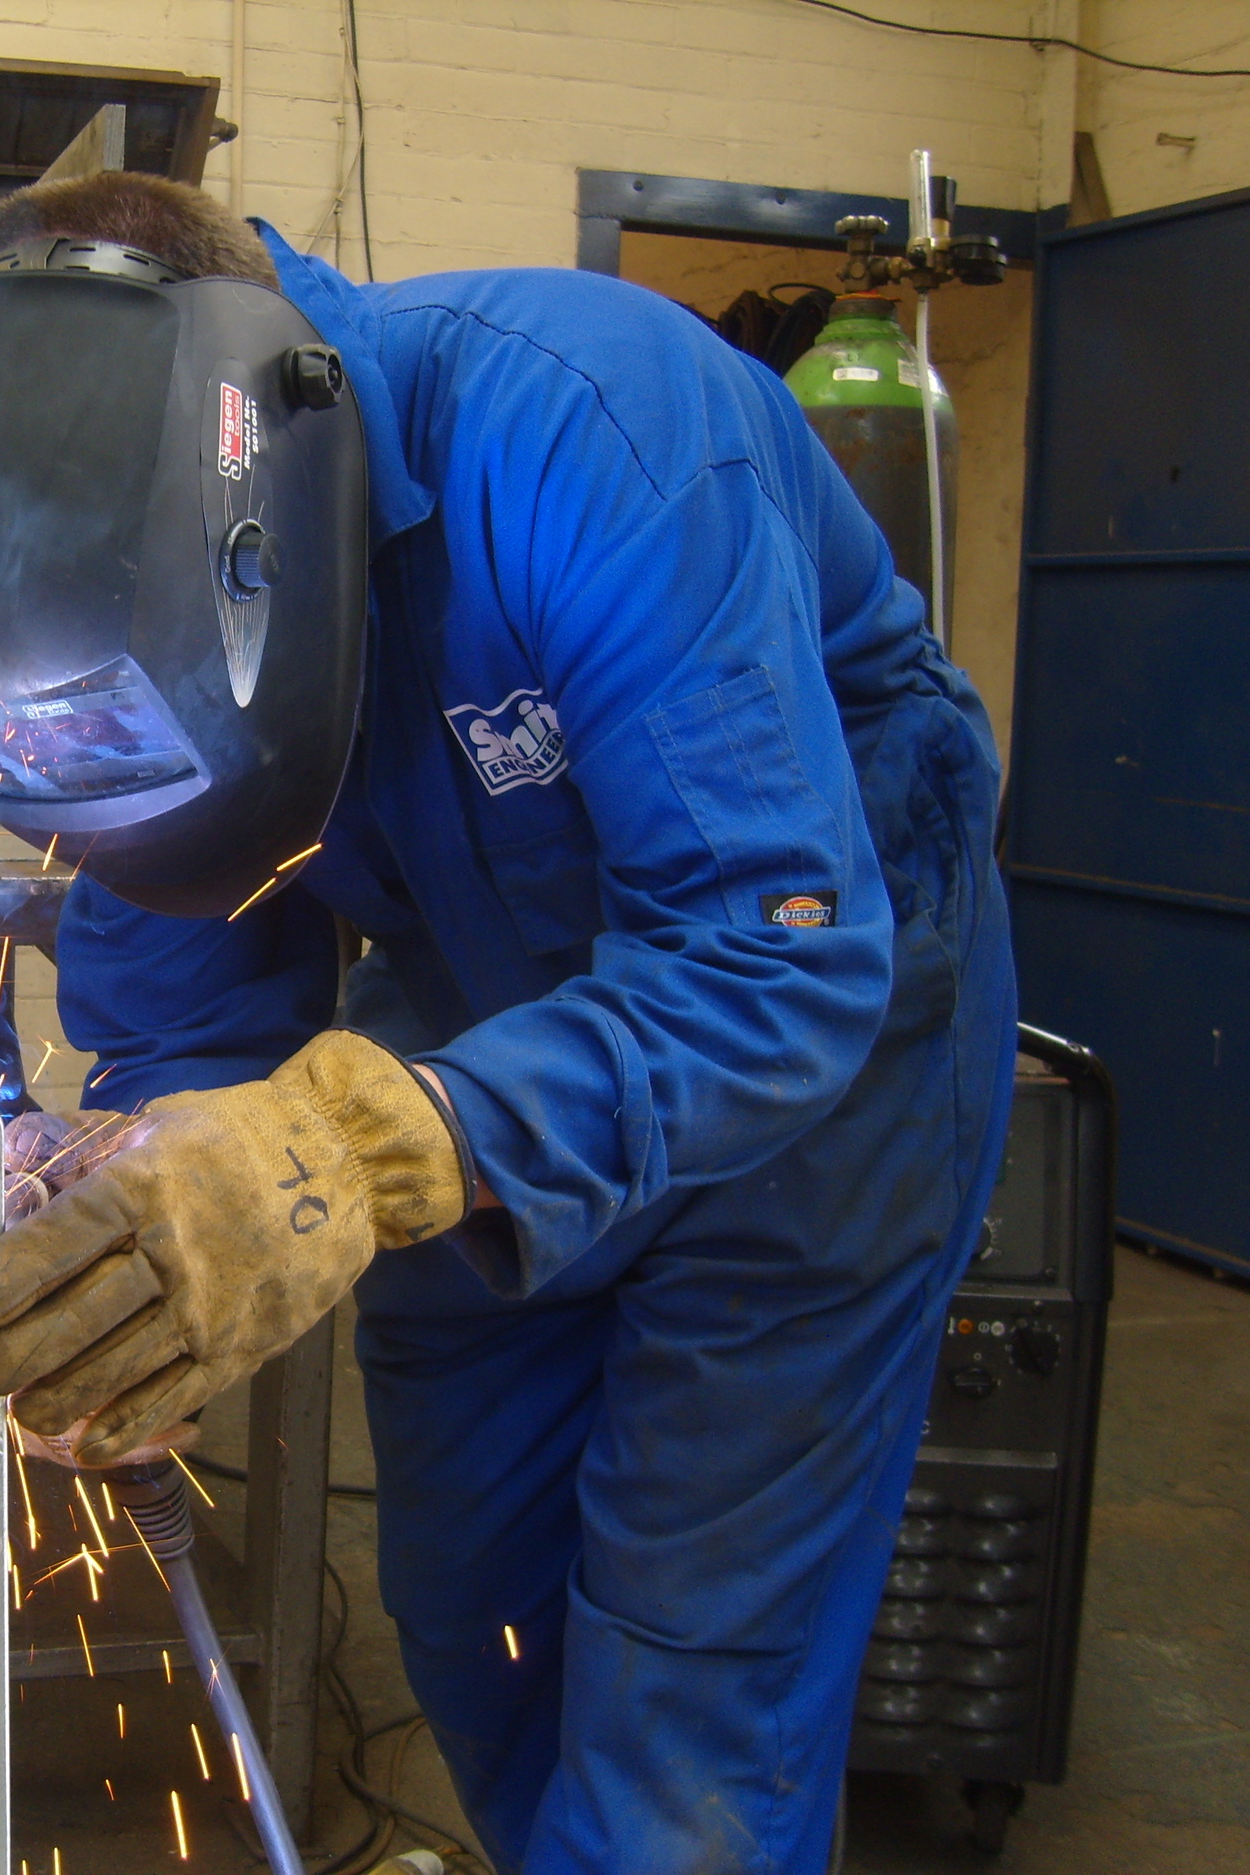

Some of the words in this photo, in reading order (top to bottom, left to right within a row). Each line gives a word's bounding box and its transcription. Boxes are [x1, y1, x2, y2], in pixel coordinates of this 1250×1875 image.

[218, 390, 242, 481] Siegen
[243, 423, 251, 470] Model
[251, 400, 259, 455] S01001
[779, 911, 825, 919] Dickies
